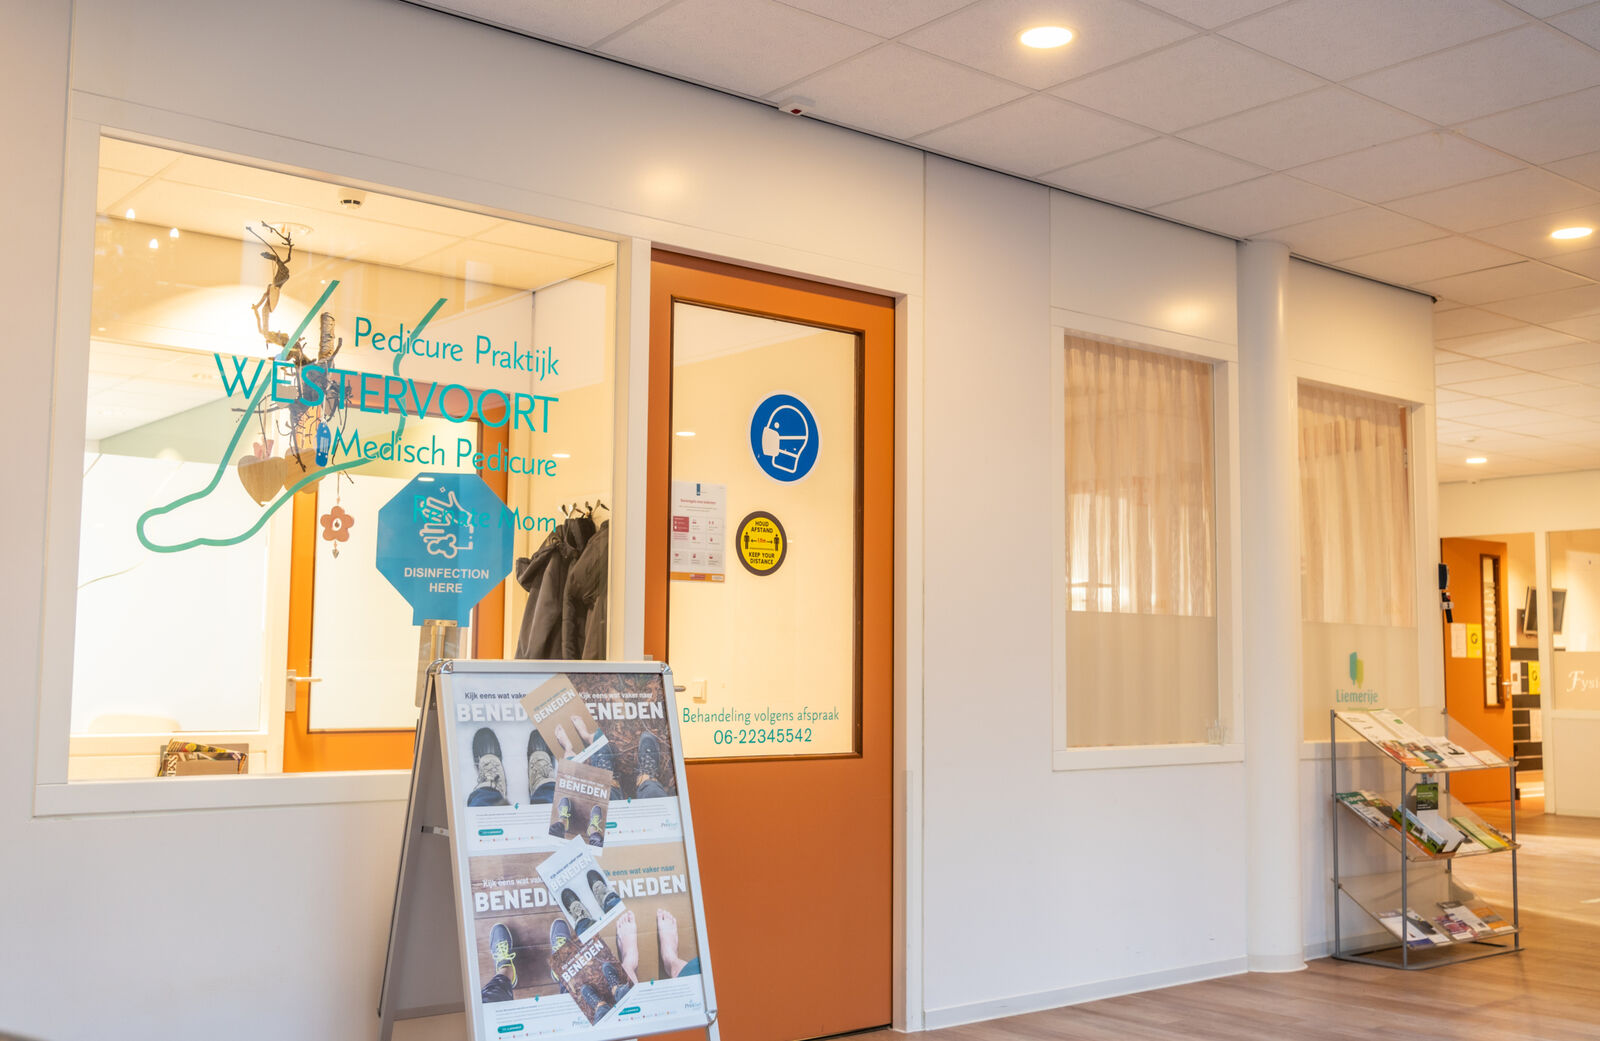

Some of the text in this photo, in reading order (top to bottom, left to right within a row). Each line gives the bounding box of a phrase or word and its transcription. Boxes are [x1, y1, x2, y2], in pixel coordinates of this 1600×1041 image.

[355, 316, 560, 381] Pedicure Praktijk
[214, 352, 559, 433] WESTERVOORT
[331, 426, 557, 477] Medisch Pedicure
[498, 505, 557, 533] Mom
[404, 567, 490, 580] DISINFECTION
[429, 582, 463, 593] HERE
[464, 692, 478, 701] Kijk
[498, 692, 510, 700] wat
[511, 692, 526, 700] vake
[534, 689, 576, 723] BENEDEN
[1336, 689, 1379, 704] Liemerije
[456, 703, 528, 722] BENED
[585, 701, 664, 720] ENEDEN
[682, 706, 840, 725] Behandeling volgens afspraak
[713, 727, 812, 745] 06-22345542
[559, 777, 608, 799] BENEDEN
[607, 874, 687, 899] ENEDEN
[474, 887, 558, 913] BENED
[561, 939, 604, 983] BENEDEN
